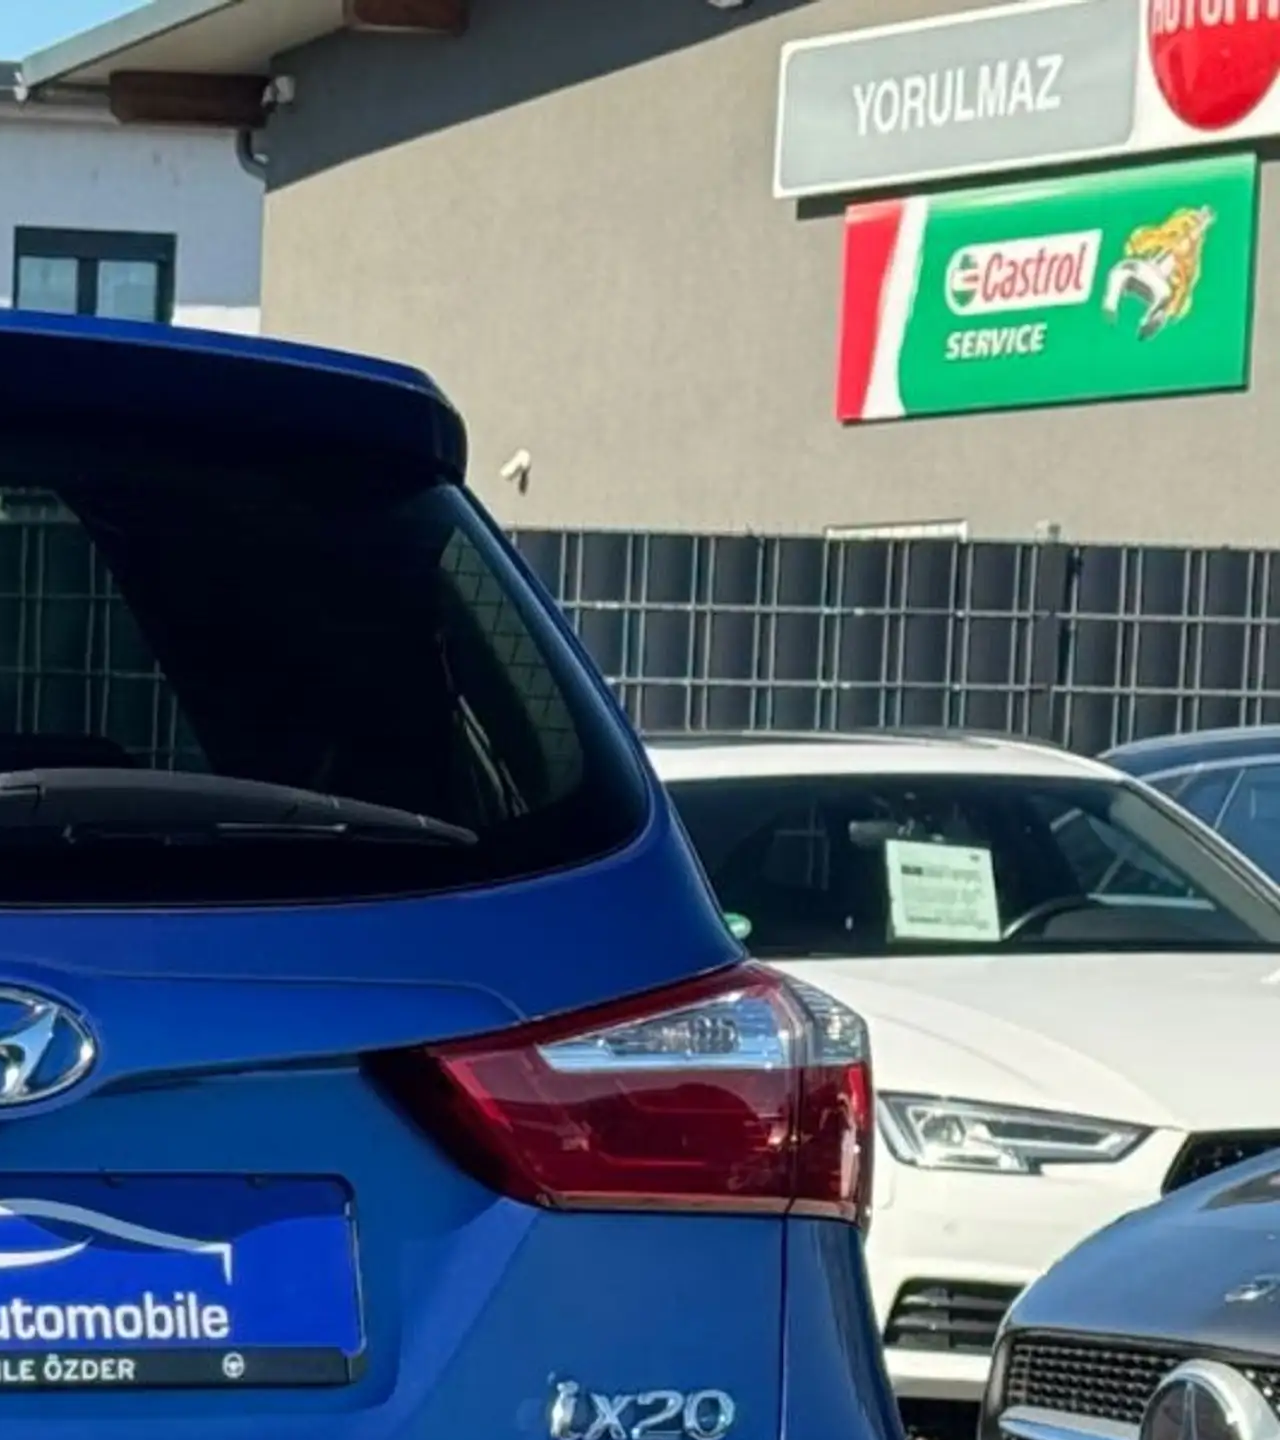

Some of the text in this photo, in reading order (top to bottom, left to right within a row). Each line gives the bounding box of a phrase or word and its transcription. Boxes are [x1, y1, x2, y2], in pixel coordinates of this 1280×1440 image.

[853, 54, 1064, 136] YORULMAZ
[981, 241, 1088, 302] Castrol
[944, 322, 1047, 361] SERVICE
[43, 1353, 136, 1382] ÖZDER
